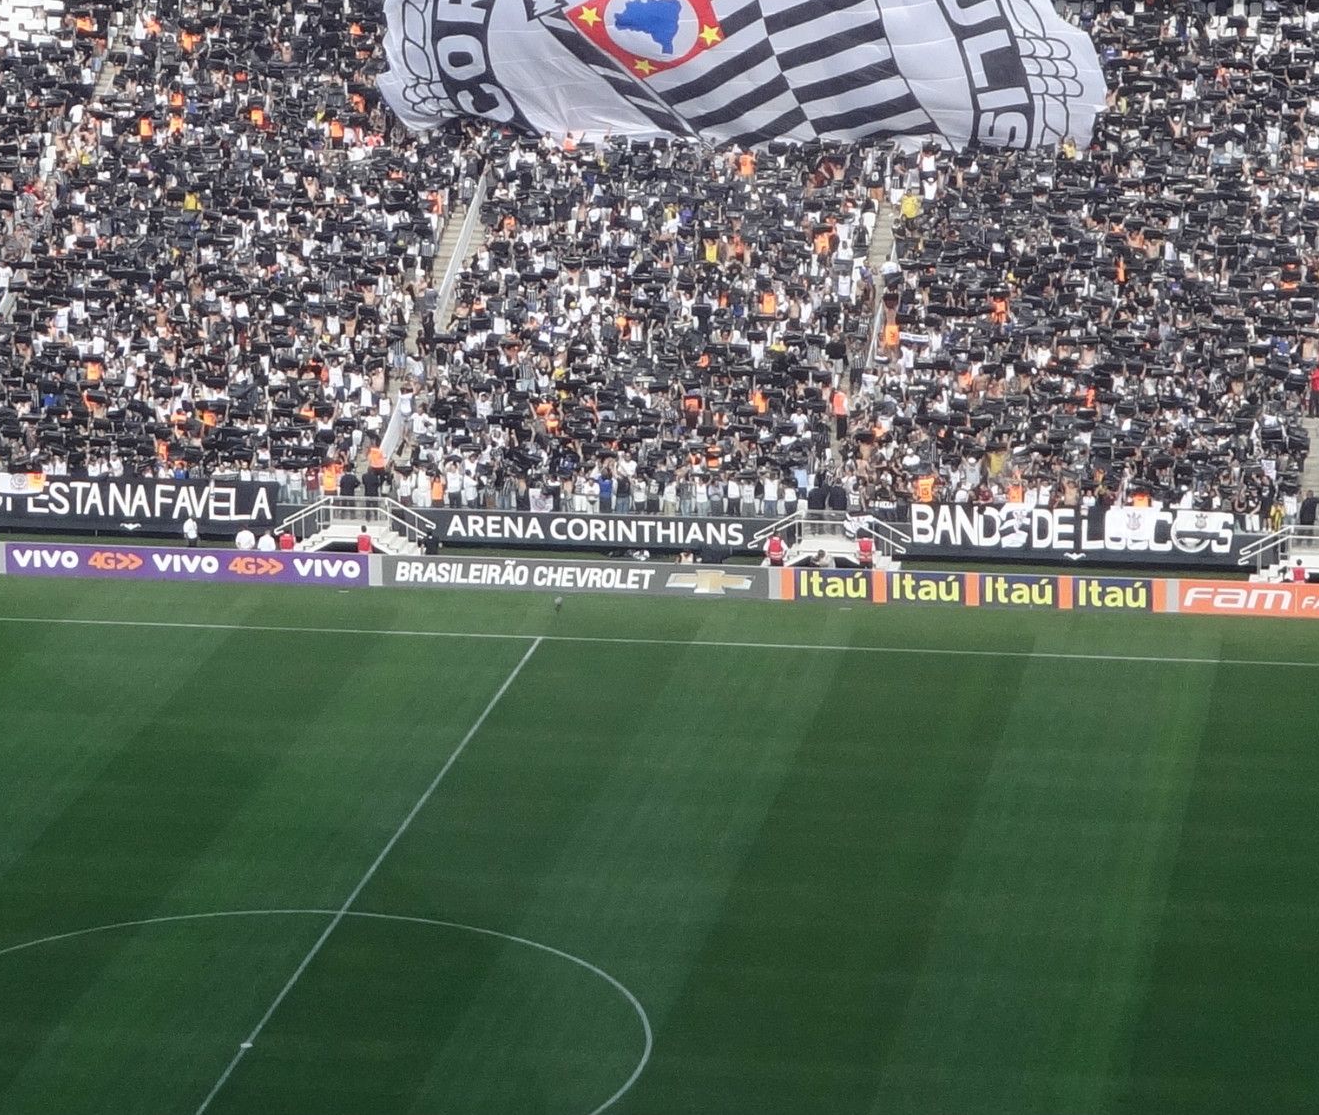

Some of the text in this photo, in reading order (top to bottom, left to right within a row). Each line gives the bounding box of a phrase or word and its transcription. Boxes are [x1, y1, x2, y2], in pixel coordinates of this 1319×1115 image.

[447, 515, 744, 546] ARENA CORINTHIANS
[1032, 508, 1075, 549] DE
[396, 558, 655, 590] BRASILEIRÃO CHEVROLET
[800, 570, 1147, 607] Itaú Itaú Itaú Itaú
